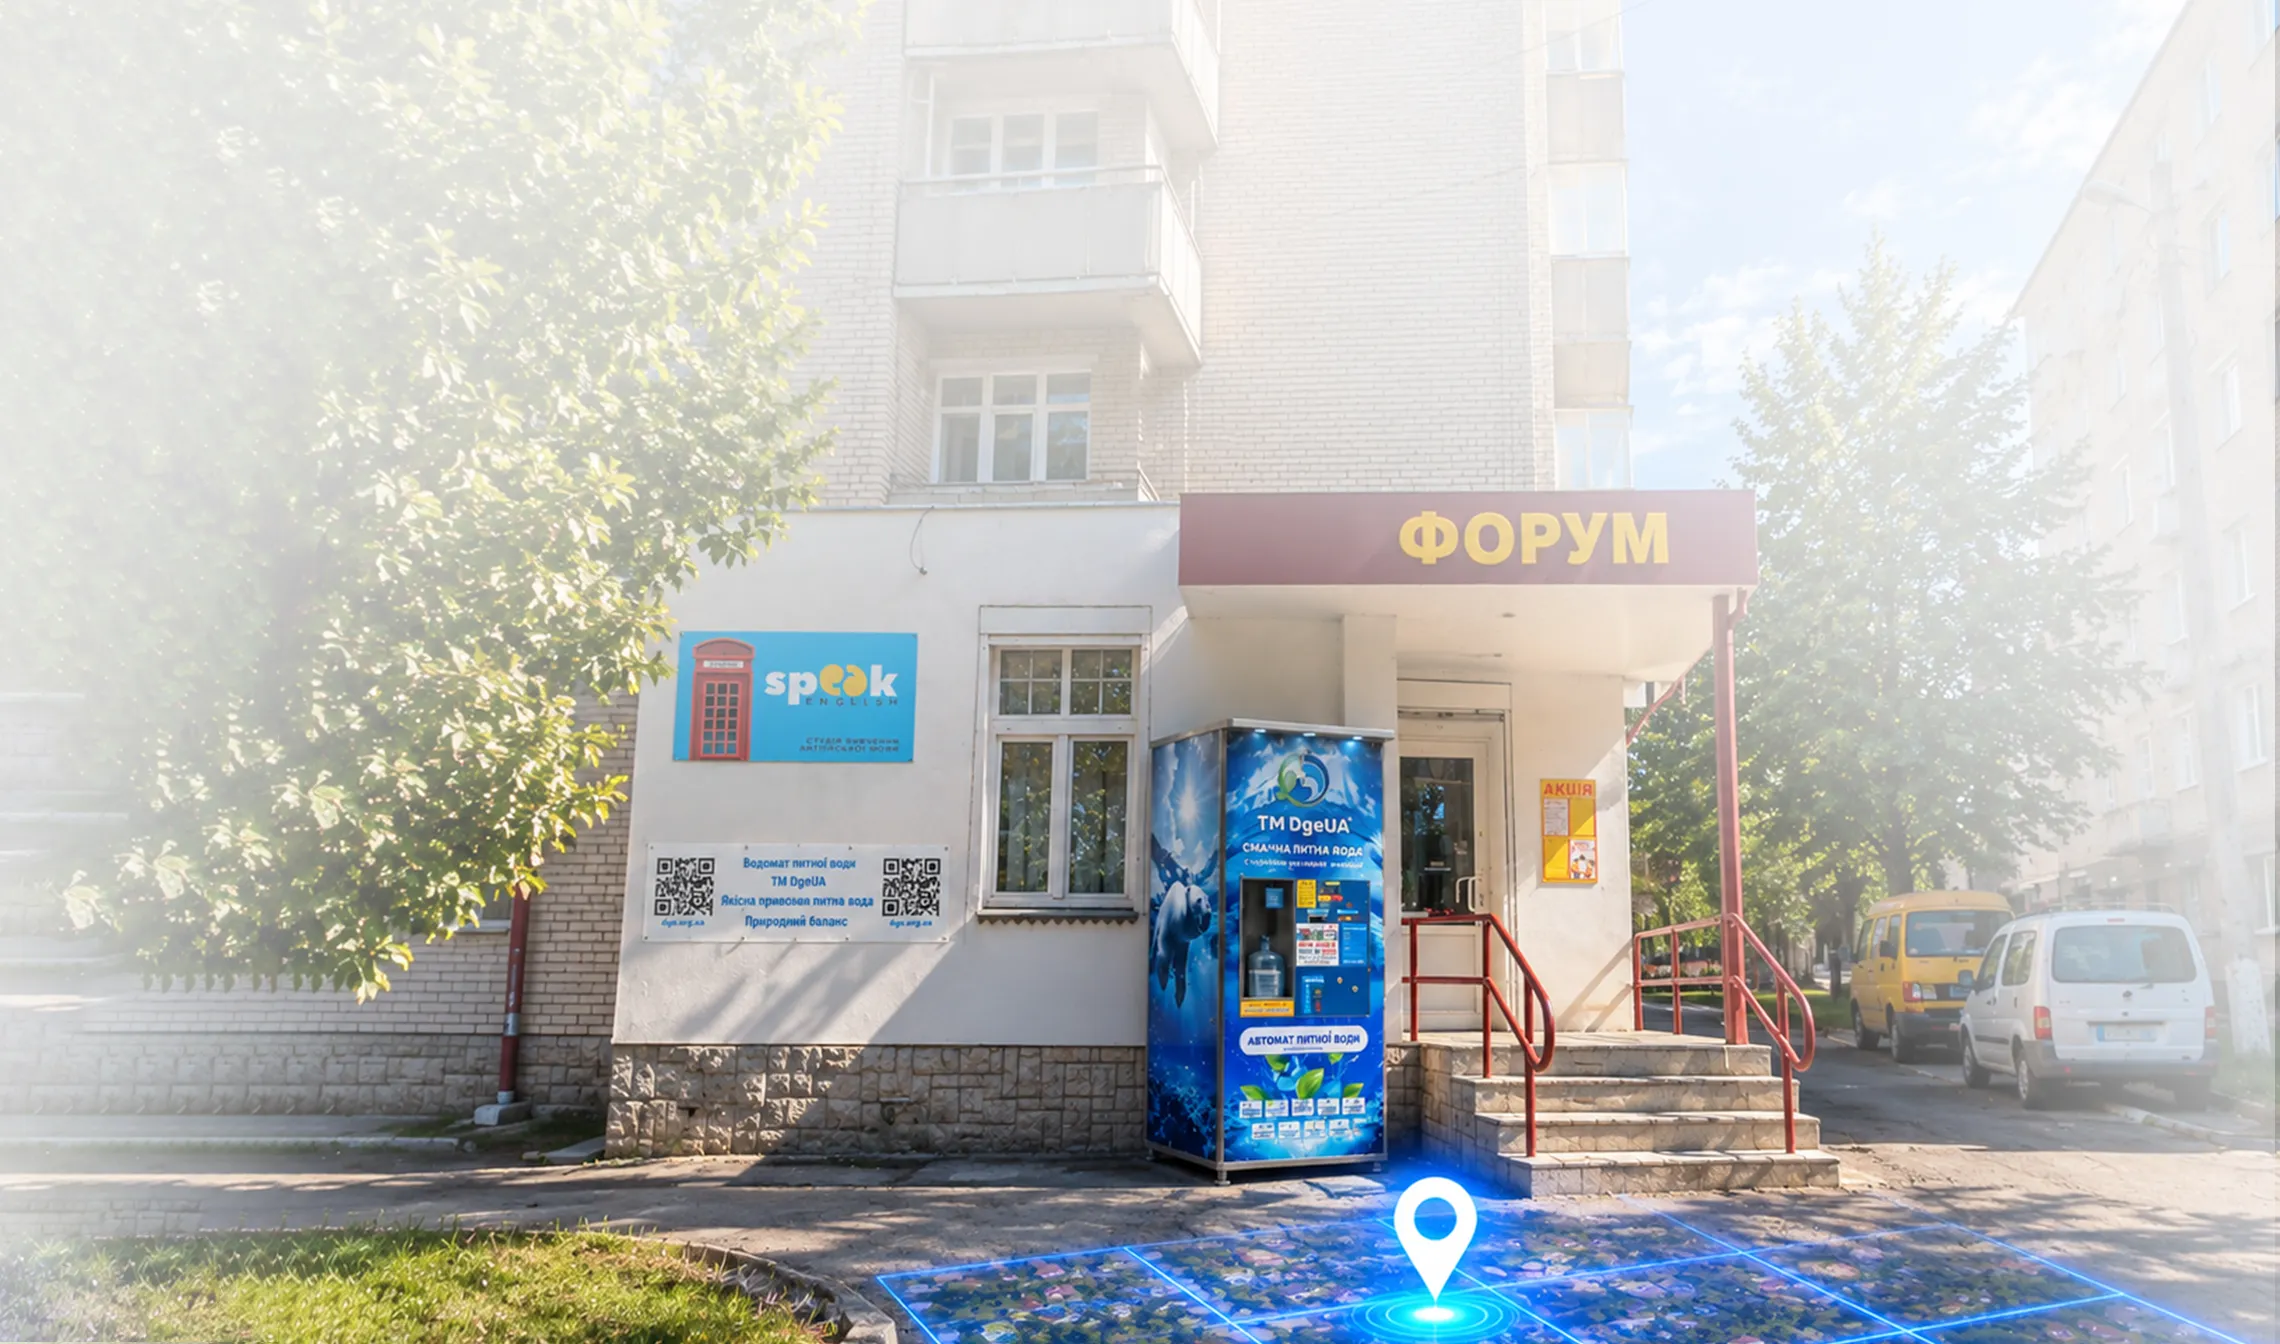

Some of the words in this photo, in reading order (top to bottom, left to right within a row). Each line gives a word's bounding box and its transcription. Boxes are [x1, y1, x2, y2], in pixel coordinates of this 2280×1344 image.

[1399, 510, 1669, 565] ФОРУМ
[764, 664, 898, 705] speak
[806, 697, 898, 706] ENGLISH
[1543, 783, 1593, 796] АКЦІЯ
[743, 857, 790, 870] Водомат
[792, 857, 827, 868] питної
[829, 859, 856, 869] води
[789, 876, 826, 889] DgeUA
[721, 895, 756, 906] Якісна
[813, 897, 845, 906] питна
[848, 897, 875, 907] вода
[745, 914, 806, 929] Природний
